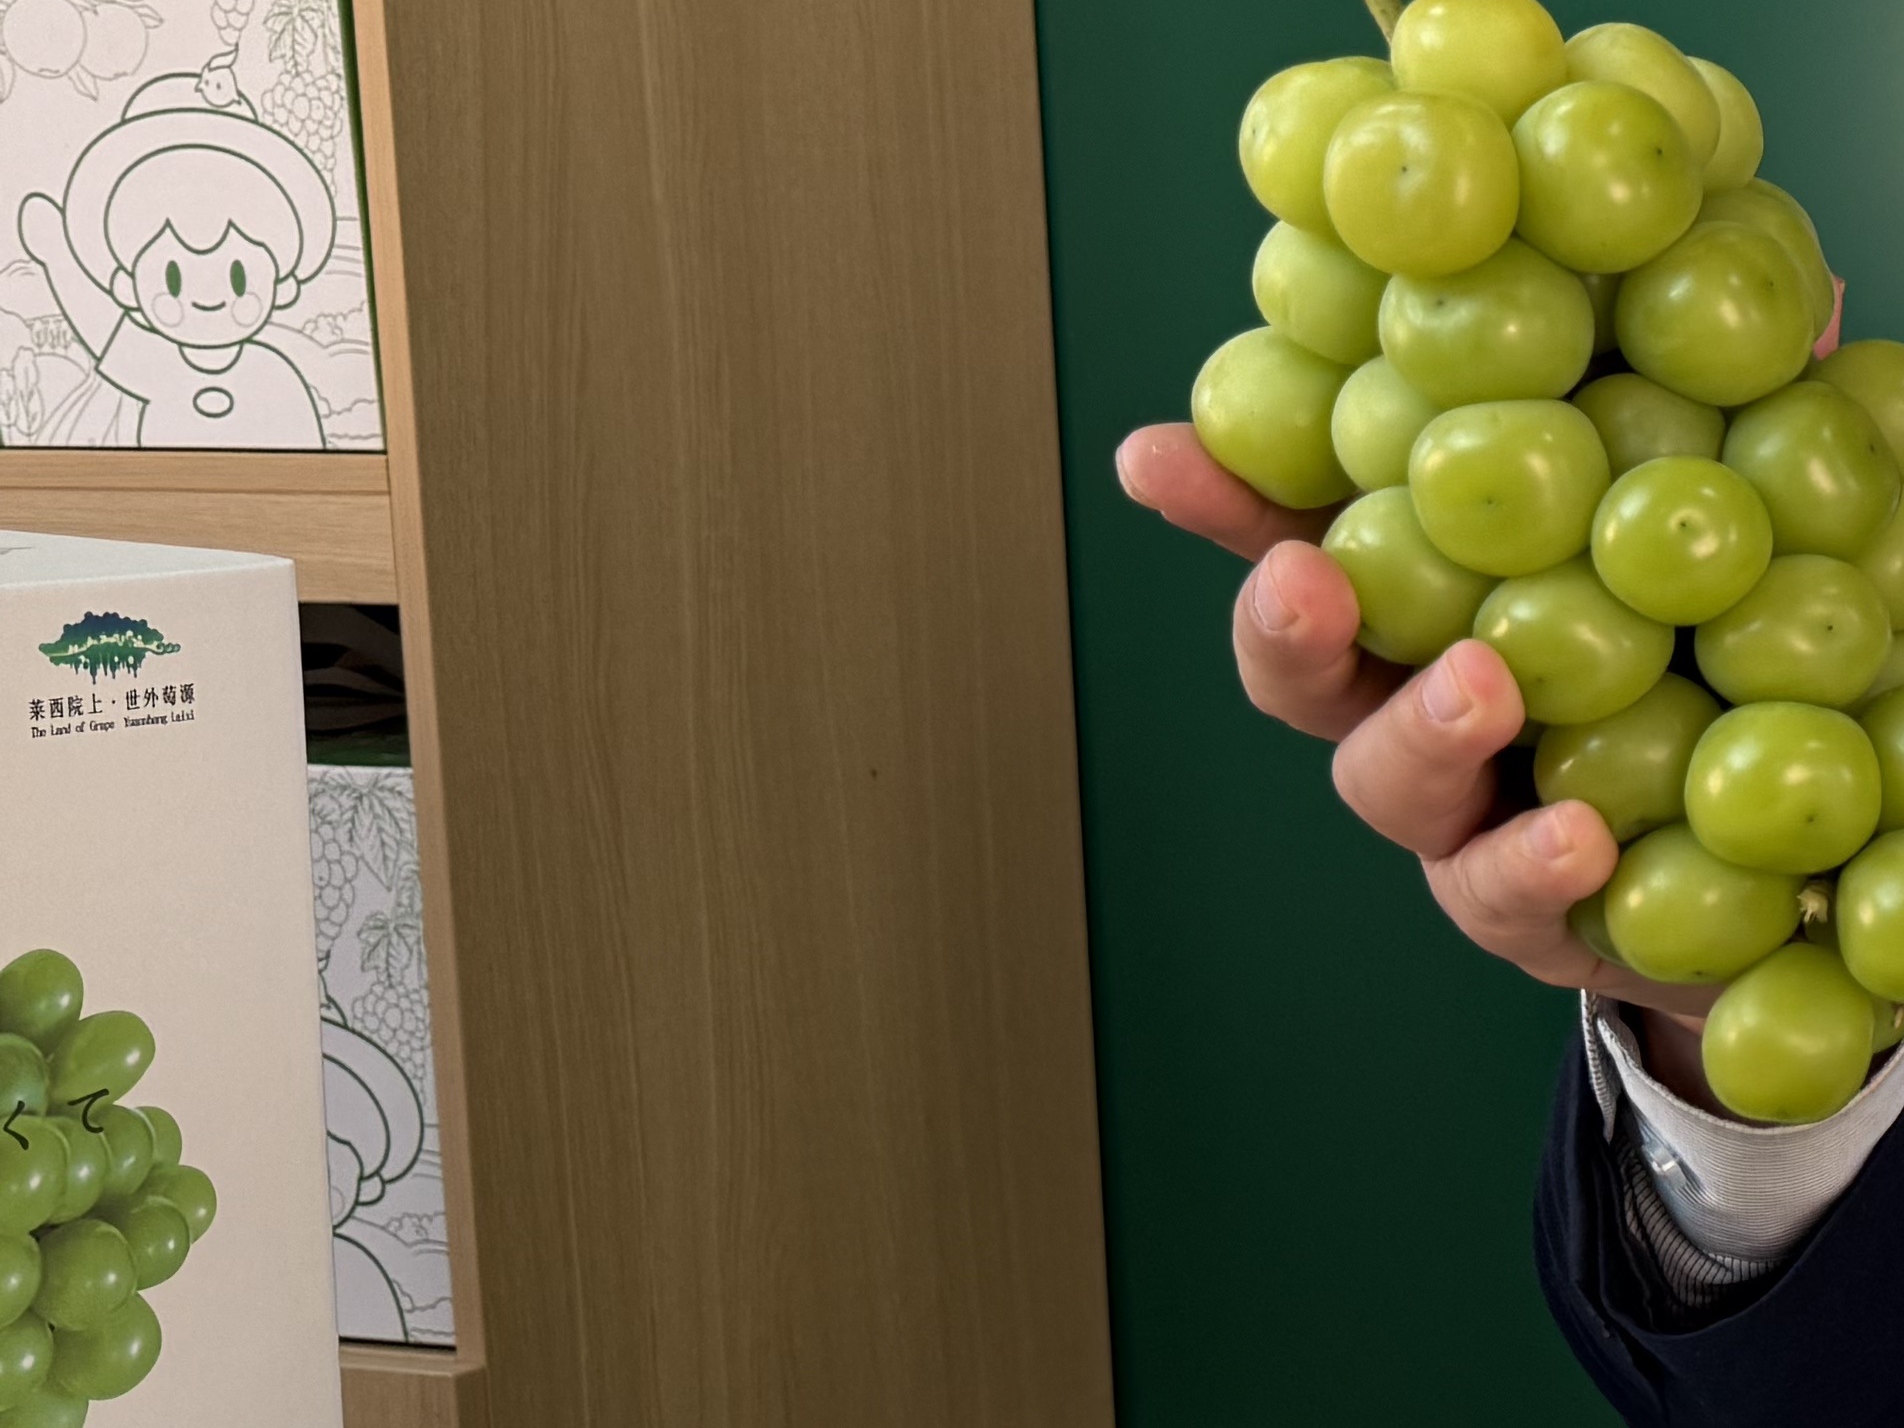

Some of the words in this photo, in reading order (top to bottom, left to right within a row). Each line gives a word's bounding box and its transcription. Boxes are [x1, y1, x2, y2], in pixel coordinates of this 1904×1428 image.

[50, 723, 72, 736] Land
[75, 721, 87, 733] of
[89, 719, 115, 732] Grape
